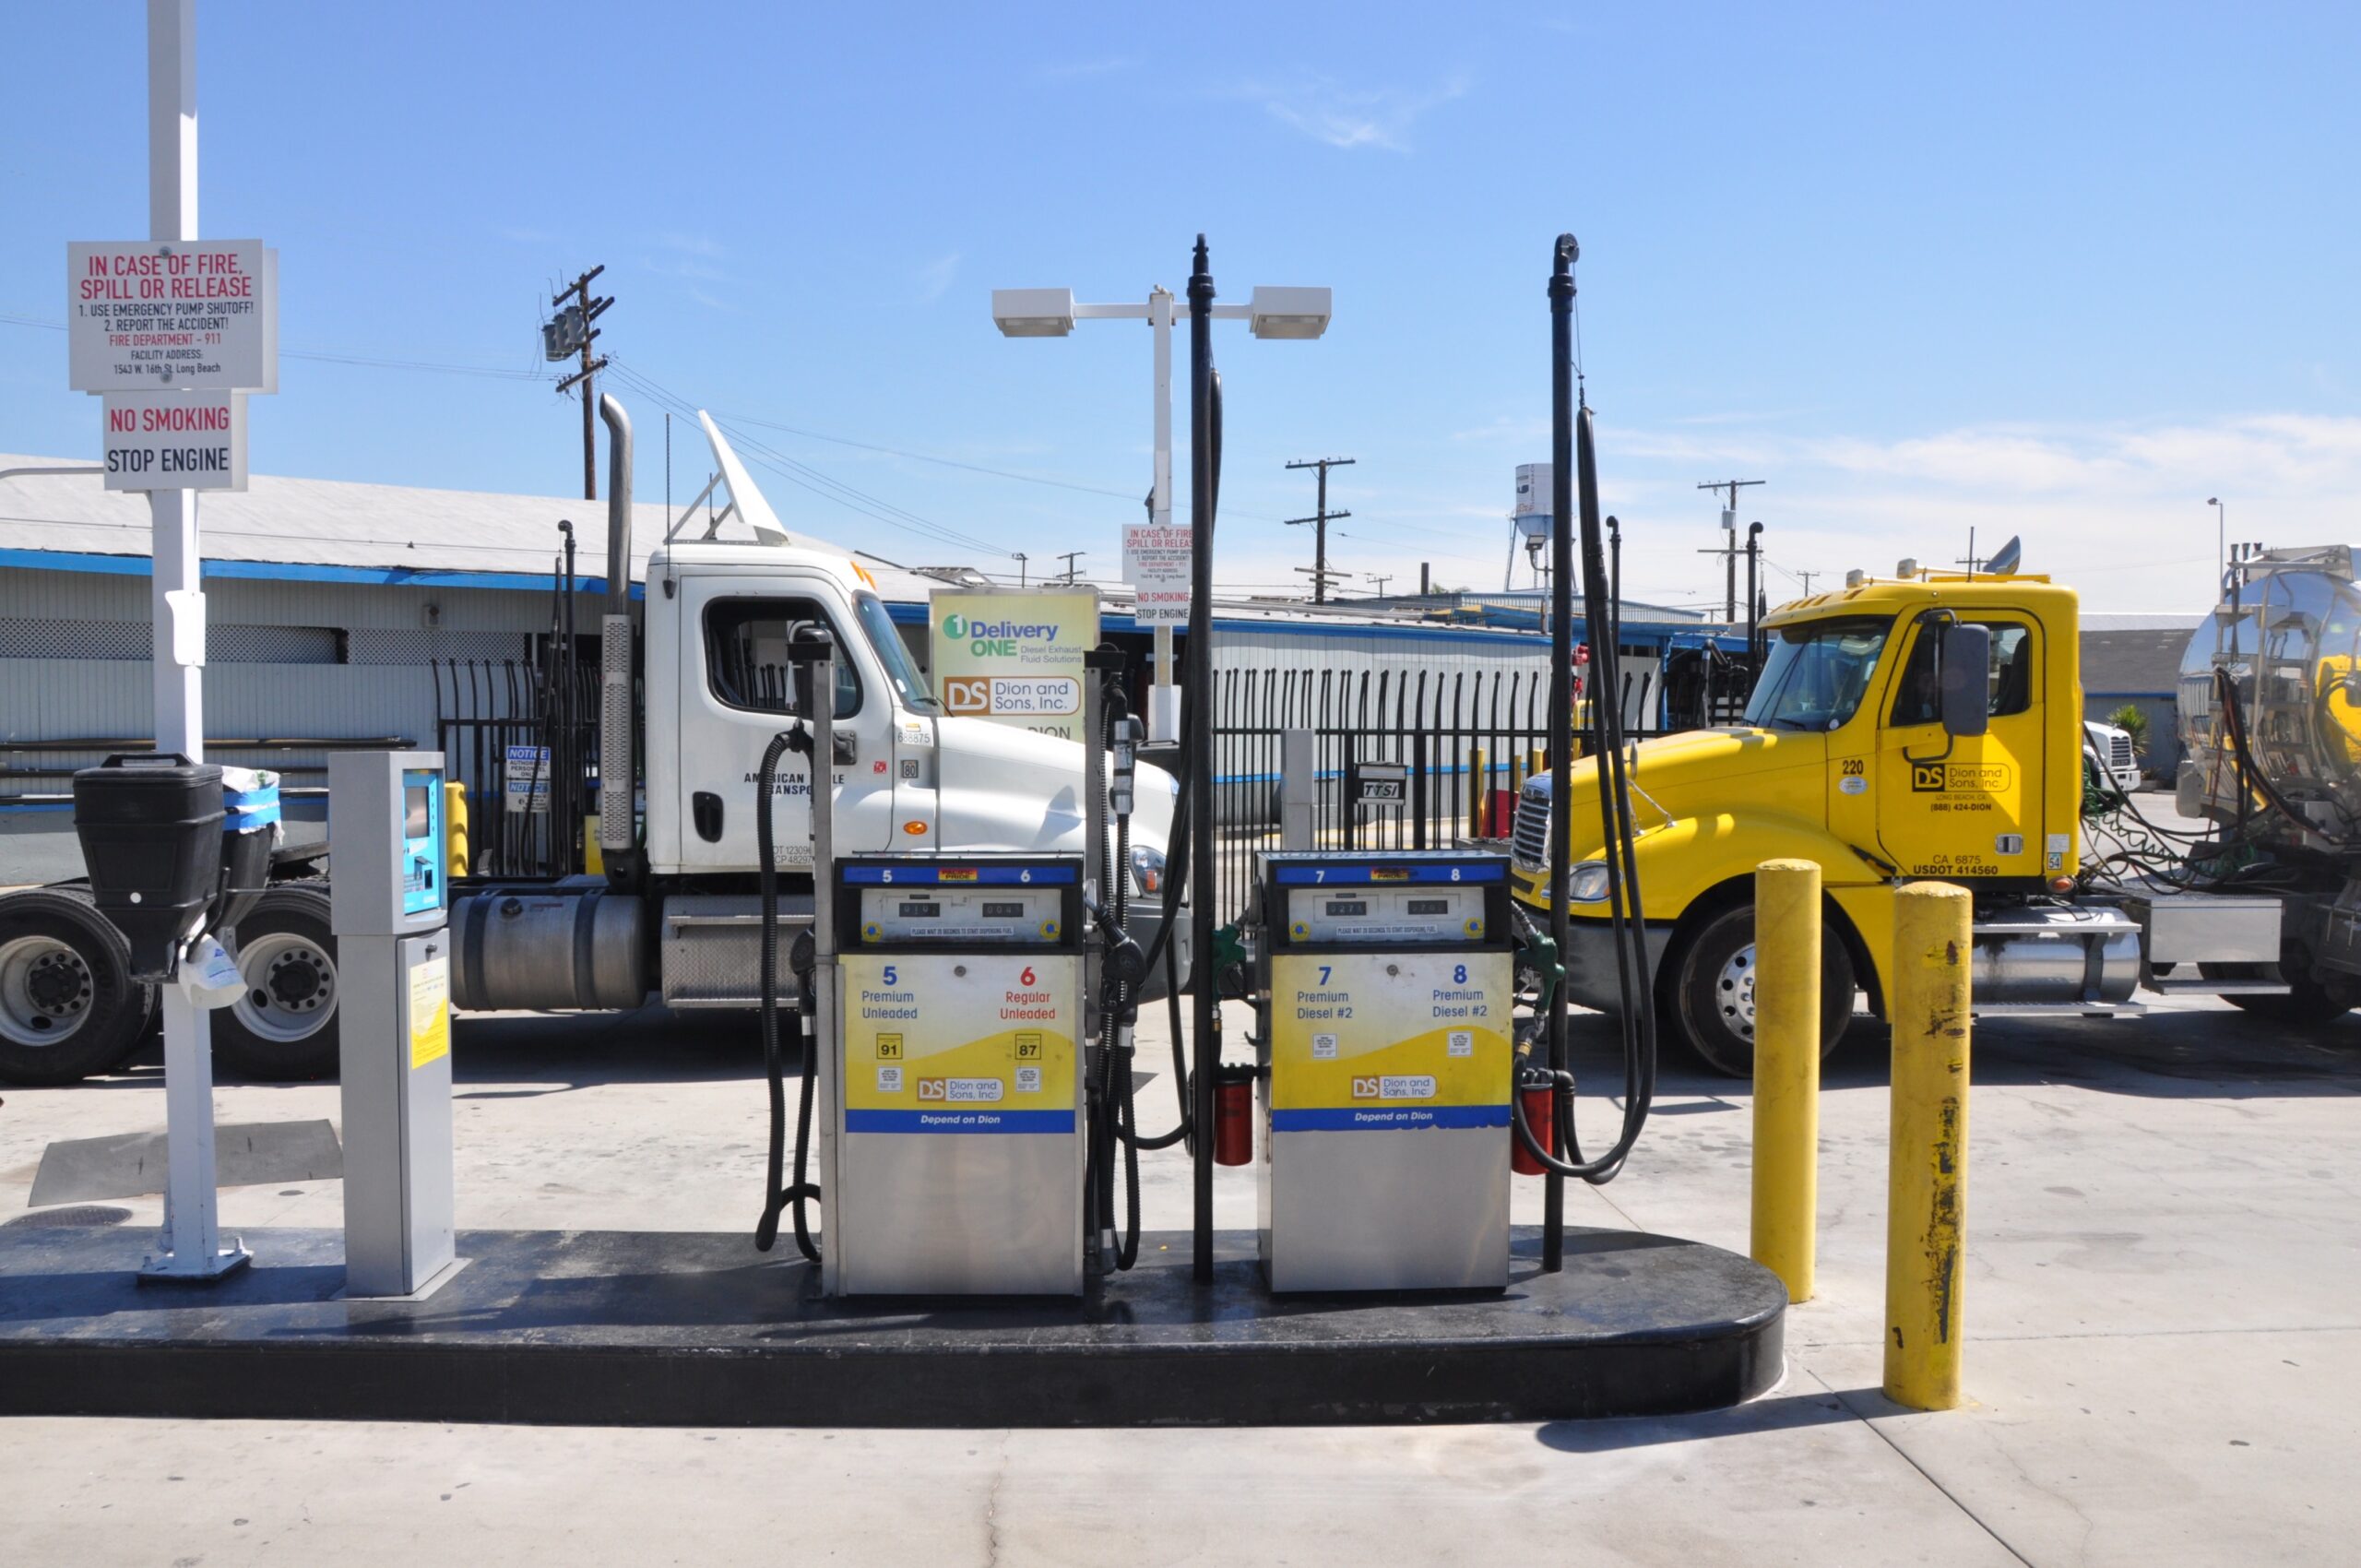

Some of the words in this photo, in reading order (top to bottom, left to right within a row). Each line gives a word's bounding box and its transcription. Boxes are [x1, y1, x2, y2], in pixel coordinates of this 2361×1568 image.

[89, 255, 108, 277] IN
[114, 255, 162, 276] CASE
[168, 254, 191, 275] OF
[197, 254, 243, 275] FIRE,
[80, 279, 134, 300] SPILL
[140, 279, 165, 299] OR
[172, 277, 252, 298] RELEASE
[78, 304, 88, 317] 1.
[90, 304, 110, 316] USE
[113, 303, 172, 316] EMERGENCY
[175, 302, 204, 315] PUMP
[207, 302, 255, 315] SHUTOFF!
[104, 320, 113, 332] 2.
[116, 319, 154, 332] REPORT
[157, 318, 175, 331] THE
[177, 317, 229, 330] ACCIDENT!
[109, 335, 130, 347] FIRE
[133, 333, 194, 346] DEPARTMENT
[205, 333, 221, 345] 911
[131, 350, 163, 361] FACILITY
[165, 349, 204, 360] ADDRESS:
[113, 364, 133, 375] 1543
[146, 364, 162, 374] 16th
[175, 363, 196, 375] Long
[196, 362, 221, 374] Beach
[110, 409, 136, 432] NO
[142, 407, 230, 432] SMOKING
[107, 448, 155, 472] STOP
[161, 447, 229, 471] ENGINE
[1131, 529, 1139, 538] IN
[1141, 529, 1161, 538] CASE
[1163, 529, 1174, 538] OF
[1127, 539, 1149, 548] SPILL
[1151, 539, 1163, 547] OR
[1165, 539, 1193, 547] RELEAS
[1137, 592, 1149, 602] NO
[1151, 592, 1189, 602] SMOKING
[1136, 609, 1157, 619] STOP
[1159, 609, 1189, 619] ENGINE
[970, 622, 1059, 641] Delivery
[970, 640, 1017, 657] ONE
[1021, 646, 1046, 654] Diesel
[1048, 646, 1082, 654] Exhaust
[948, 681, 989, 711] DS
[995, 682, 1031, 695] Dion
[1037, 683, 1068, 695] and
[994, 696, 1035, 710] Sons,
[1039, 697, 1068, 709] Inc.
[905, 765, 916, 777] 80
[1843, 759, 1864, 775] 220
[743, 773, 804, 783] AMICAN
[1915, 766, 1943, 789] DS
[1949, 767, 1975, 778] Dion
[1978, 768, 2002, 778] and
[1949, 778, 1978, 789] Sons,
[1930, 803, 1951, 812] (888)
[1932, 855, 1949, 864] CA
[1954, 855, 1981, 864] 6875
[2049, 857, 2059, 868] 54
[1913, 865, 1953, 874] USDOT
[1956, 865, 1998, 874] 414560
[882, 870, 893, 883] 5
[1020, 869, 1031, 883] 6
[1315, 870, 1325, 884] 7
[1451, 868, 1461, 882] 8
[883, 966, 897, 985] 5
[1020, 967, 1036, 986] 6
[1318, 966, 1332, 985] 7
[1453, 965, 1467, 984] 8
[861, 991, 914, 1003] Premium
[1005, 992, 1050, 1005] Regular
[1297, 991, 1349, 1003] Premium
[1432, 989, 1483, 1001] Premium
[861, 1007, 918, 1019] Unleaded
[1000, 1007, 1056, 1019] Unleaded
[1297, 1007, 1333, 1019] Diesel
[1337, 1007, 1353, 1018] #2
[1432, 1005, 1468, 1017] Diesel
[1472, 1005, 1488, 1016] #2
[881, 1044, 897, 1056] 91
[1019, 1044, 1037, 1056] 87
[919, 1080, 944, 1099] DS
[950, 1081, 973, 1090] Dion
[976, 1081, 997, 1090] and
[1353, 1077, 1379, 1098] DS
[1383, 1078, 1407, 1087] Dion
[1410, 1078, 1430, 1087] and
[949, 1090, 976, 1100] Sons,
[920, 1114, 960, 1124] Depend
[978, 1114, 1001, 1123] Dion
[1355, 1111, 1394, 1122] Depend
[1410, 1111, 1432, 1121] Dion
